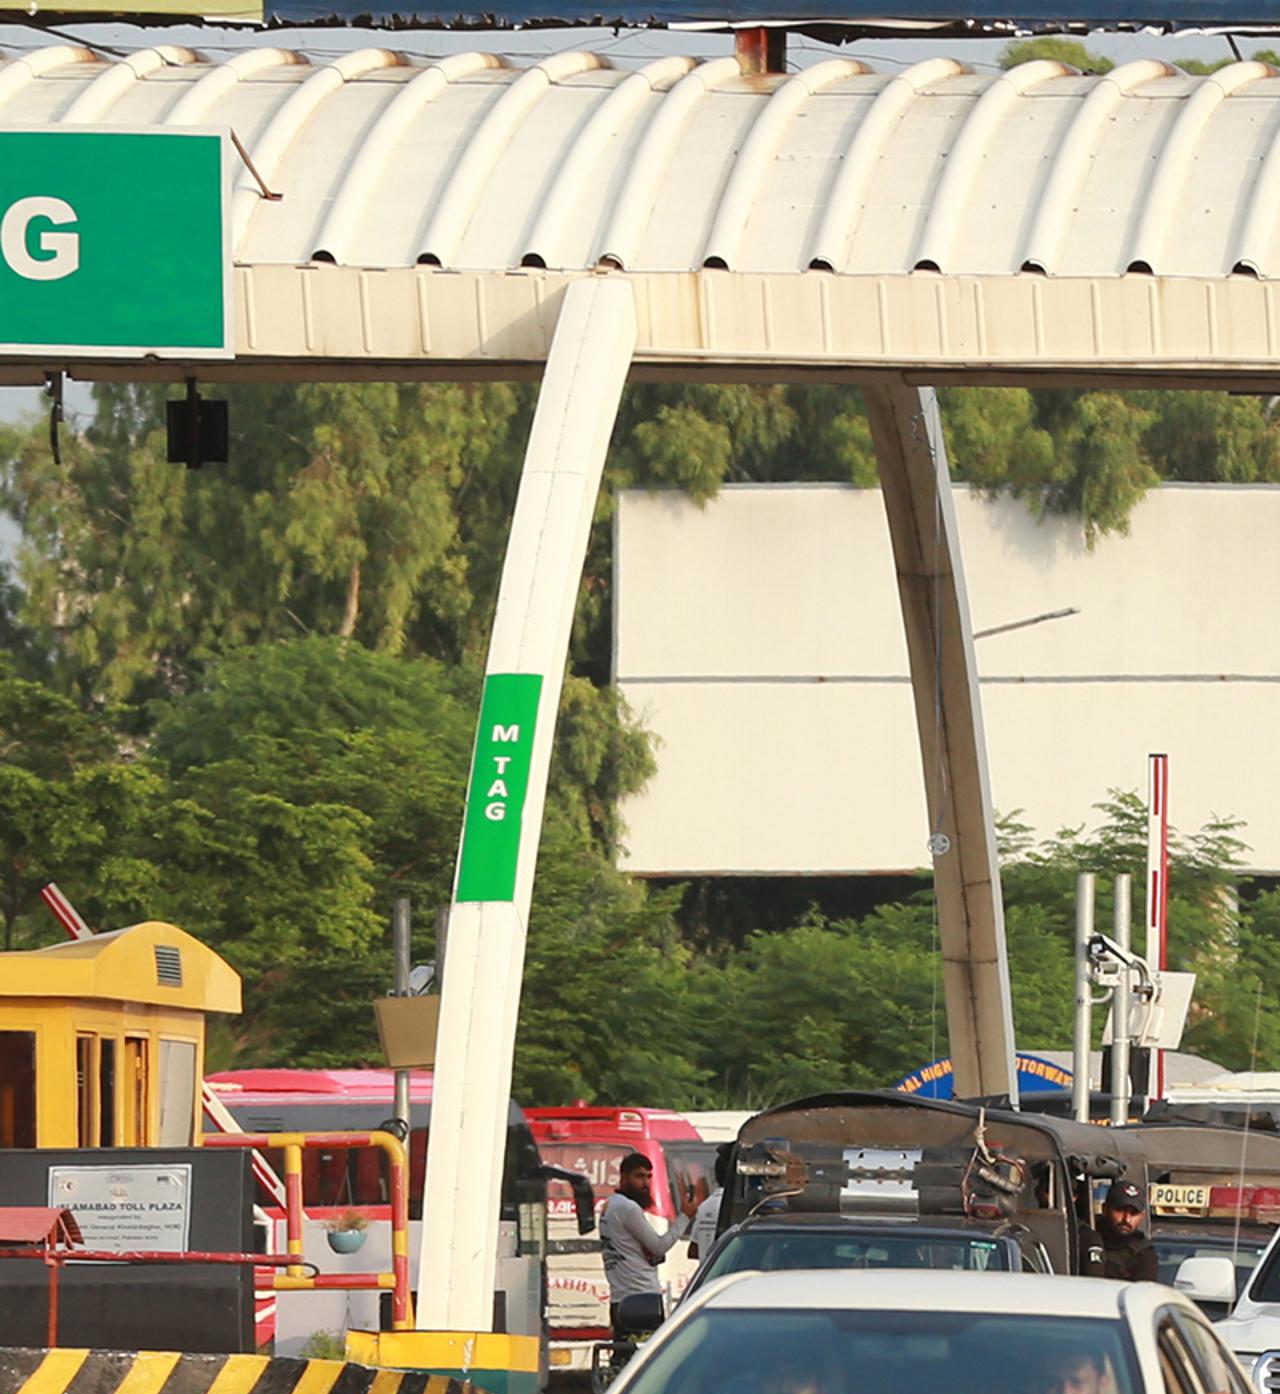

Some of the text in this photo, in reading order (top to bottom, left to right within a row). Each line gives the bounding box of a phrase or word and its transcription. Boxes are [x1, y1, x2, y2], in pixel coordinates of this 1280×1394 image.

[1, 196, 80, 281] G
[1156, 1188, 1204, 1204] POLICE
[120, 1203, 145, 1211] TOLL
[148, 1202, 182, 1211] PLAZA
